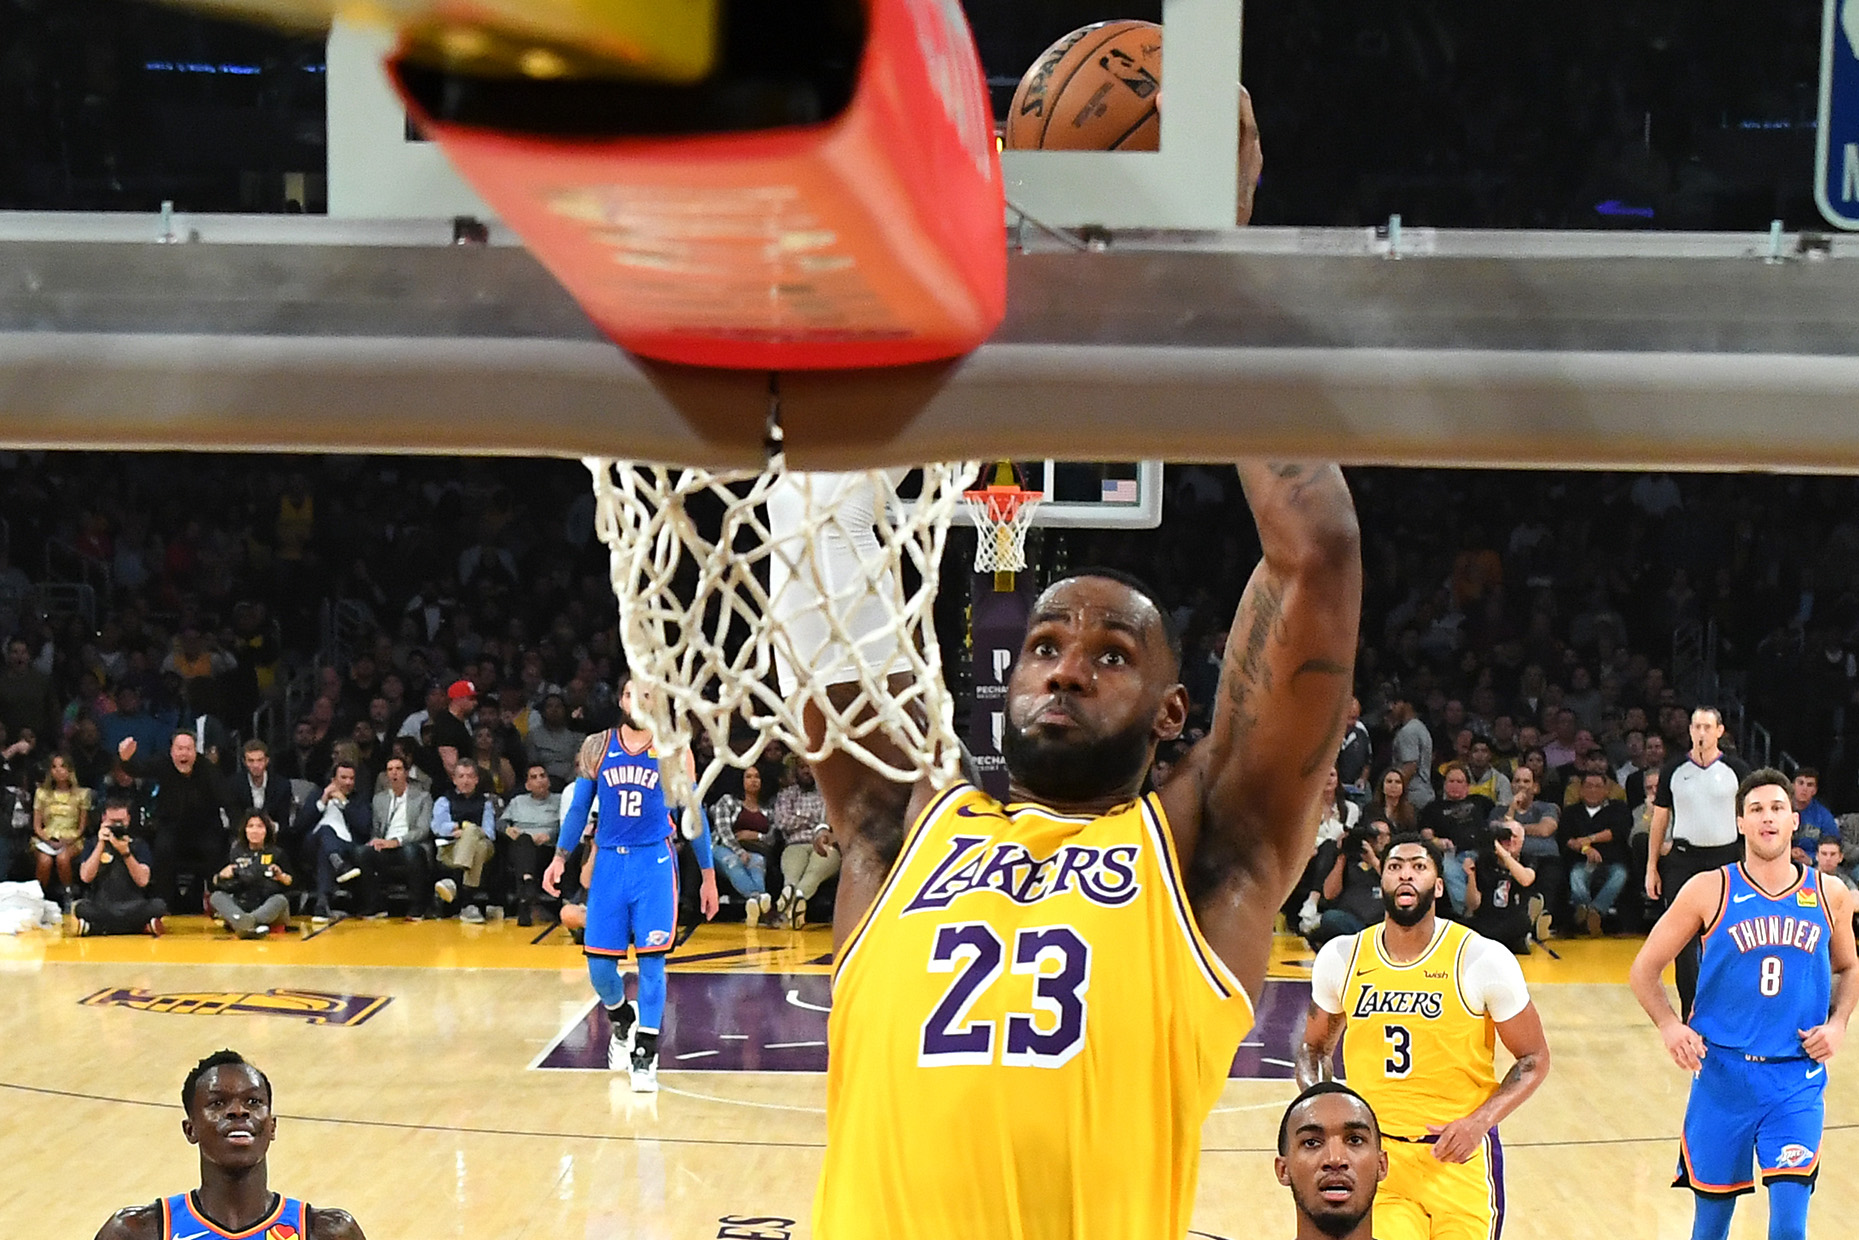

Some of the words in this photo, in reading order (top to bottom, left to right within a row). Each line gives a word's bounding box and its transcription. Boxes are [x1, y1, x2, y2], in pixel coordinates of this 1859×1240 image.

[976, 686, 1009, 694] PECHA
[602, 765, 660, 790] THUNDER
[618, 789, 642, 817] 12
[899, 834, 1142, 919] LAKERS
[1727, 915, 1821, 955] THUNDER
[917, 920, 1092, 1069] 23
[1759, 955, 1783, 997] 8
[1352, 983, 1443, 1020] LAKERS
[1384, 1024, 1413, 1079] 3
